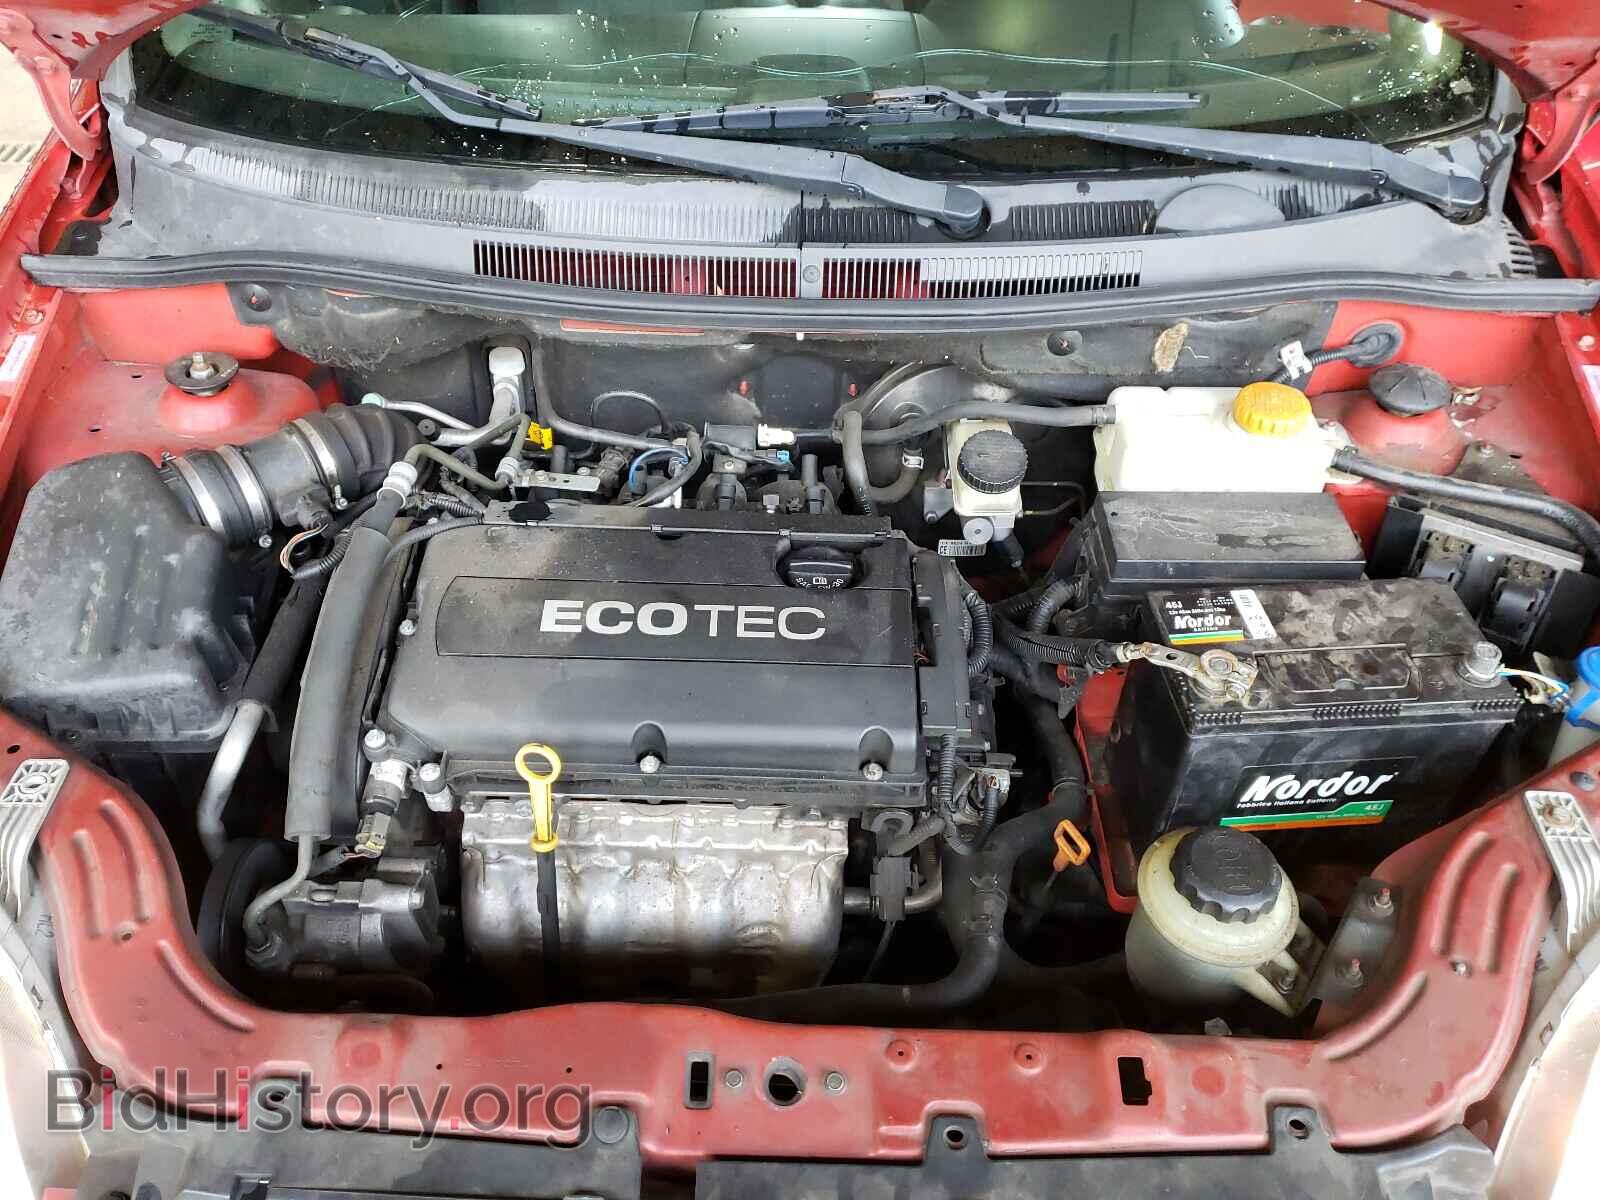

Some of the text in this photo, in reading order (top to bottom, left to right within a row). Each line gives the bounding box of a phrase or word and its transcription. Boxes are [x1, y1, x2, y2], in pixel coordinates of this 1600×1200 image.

[539, 599, 826, 640] ECOTEC
[1174, 613, 1232, 630] Nordor
[1239, 771, 1395, 803] Nordor
